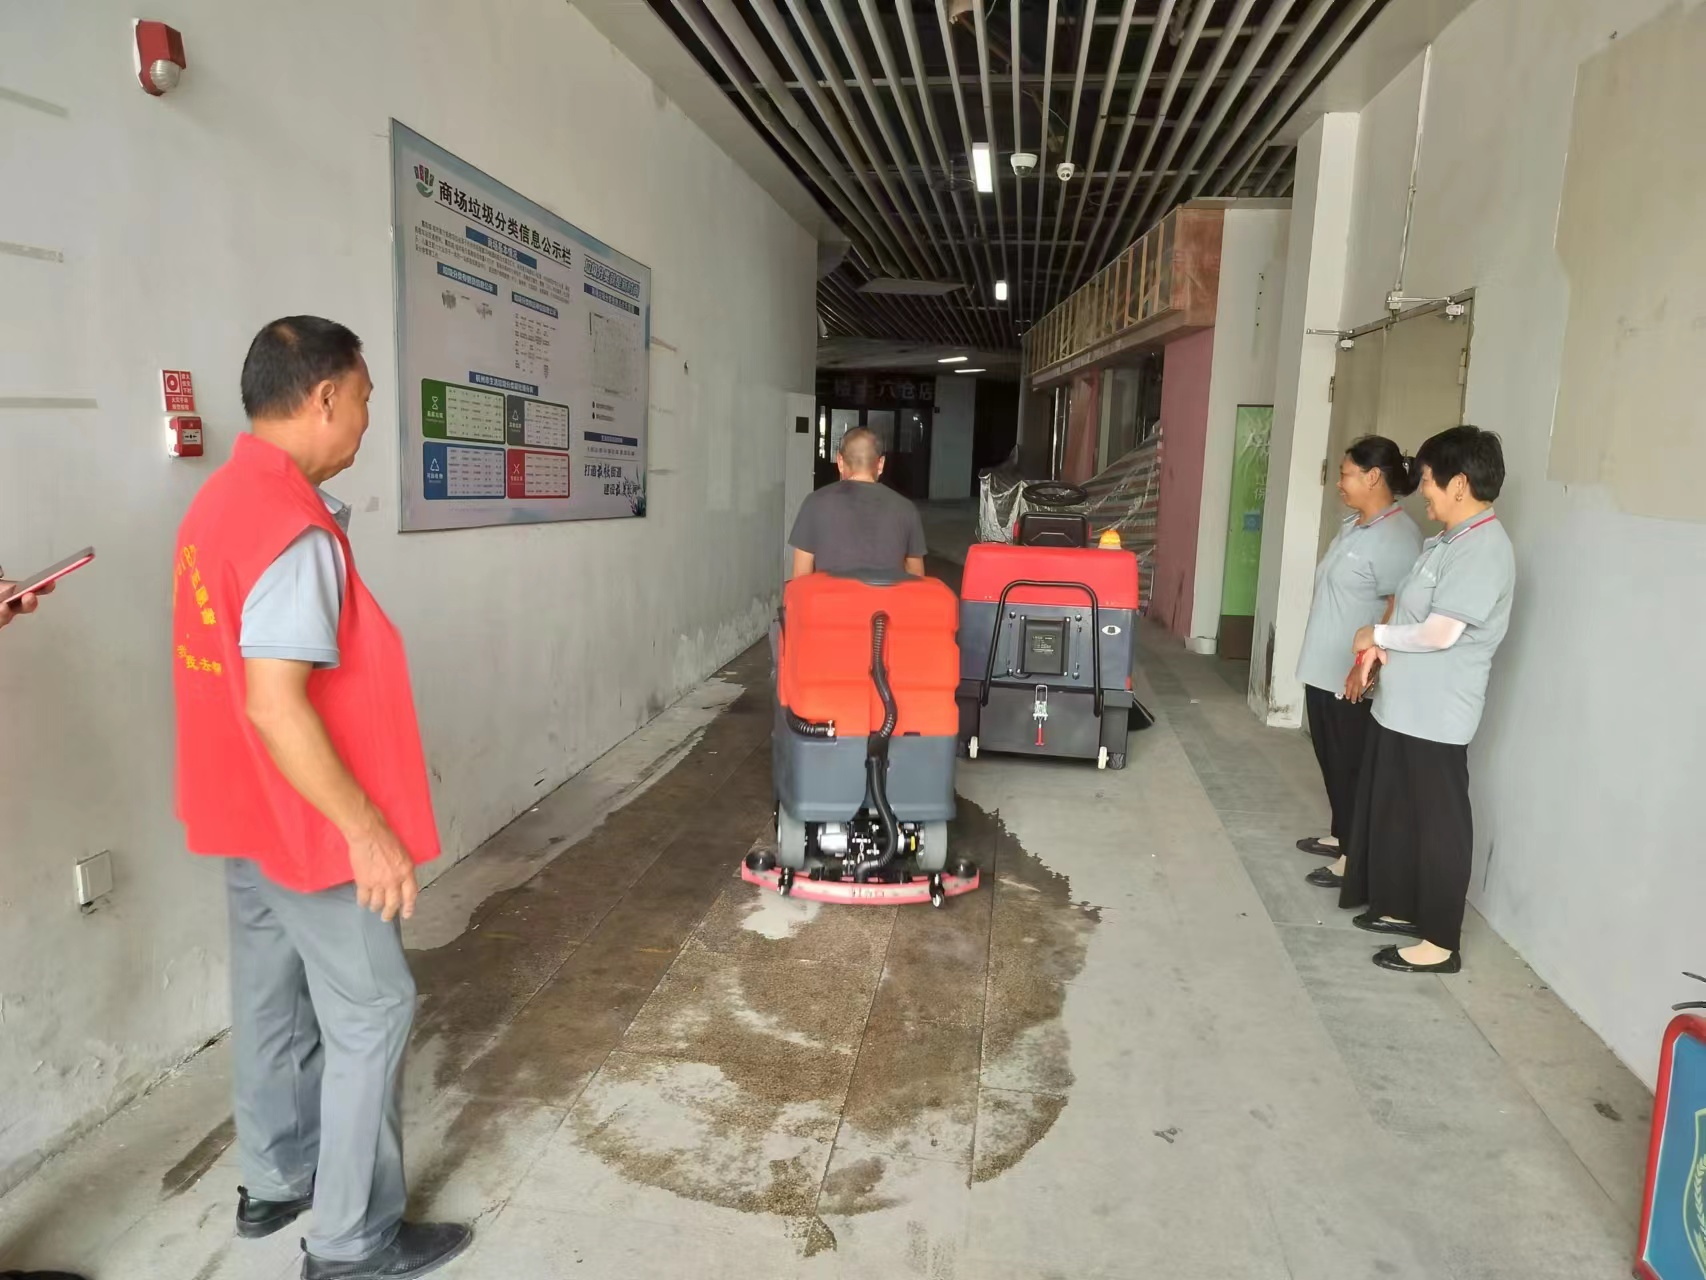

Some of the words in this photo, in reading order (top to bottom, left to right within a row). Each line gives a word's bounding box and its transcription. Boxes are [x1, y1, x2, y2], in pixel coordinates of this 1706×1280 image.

[438, 181, 572, 266] 商场垃圾分类信息公示栏
